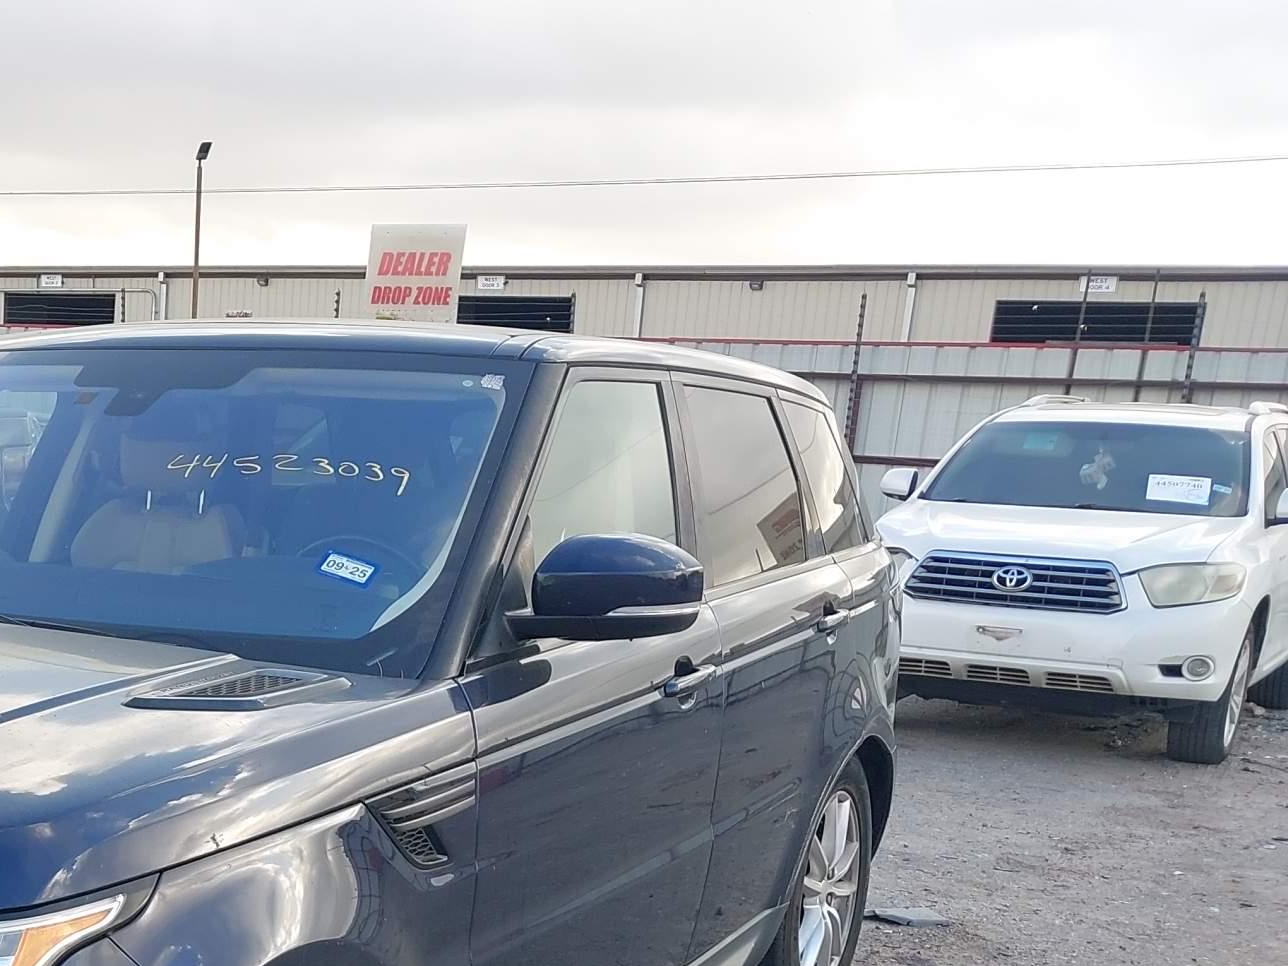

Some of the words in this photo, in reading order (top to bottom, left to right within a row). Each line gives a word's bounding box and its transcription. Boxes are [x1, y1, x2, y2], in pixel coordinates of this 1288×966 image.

[377, 252, 452, 277] DEALER
[371, 286, 412, 305] DROP
[413, 286, 453, 306] ZONE
[168, 453, 410, 496] 44523039
[326, 559, 345, 571] 09
[349, 566, 369, 579] 25
